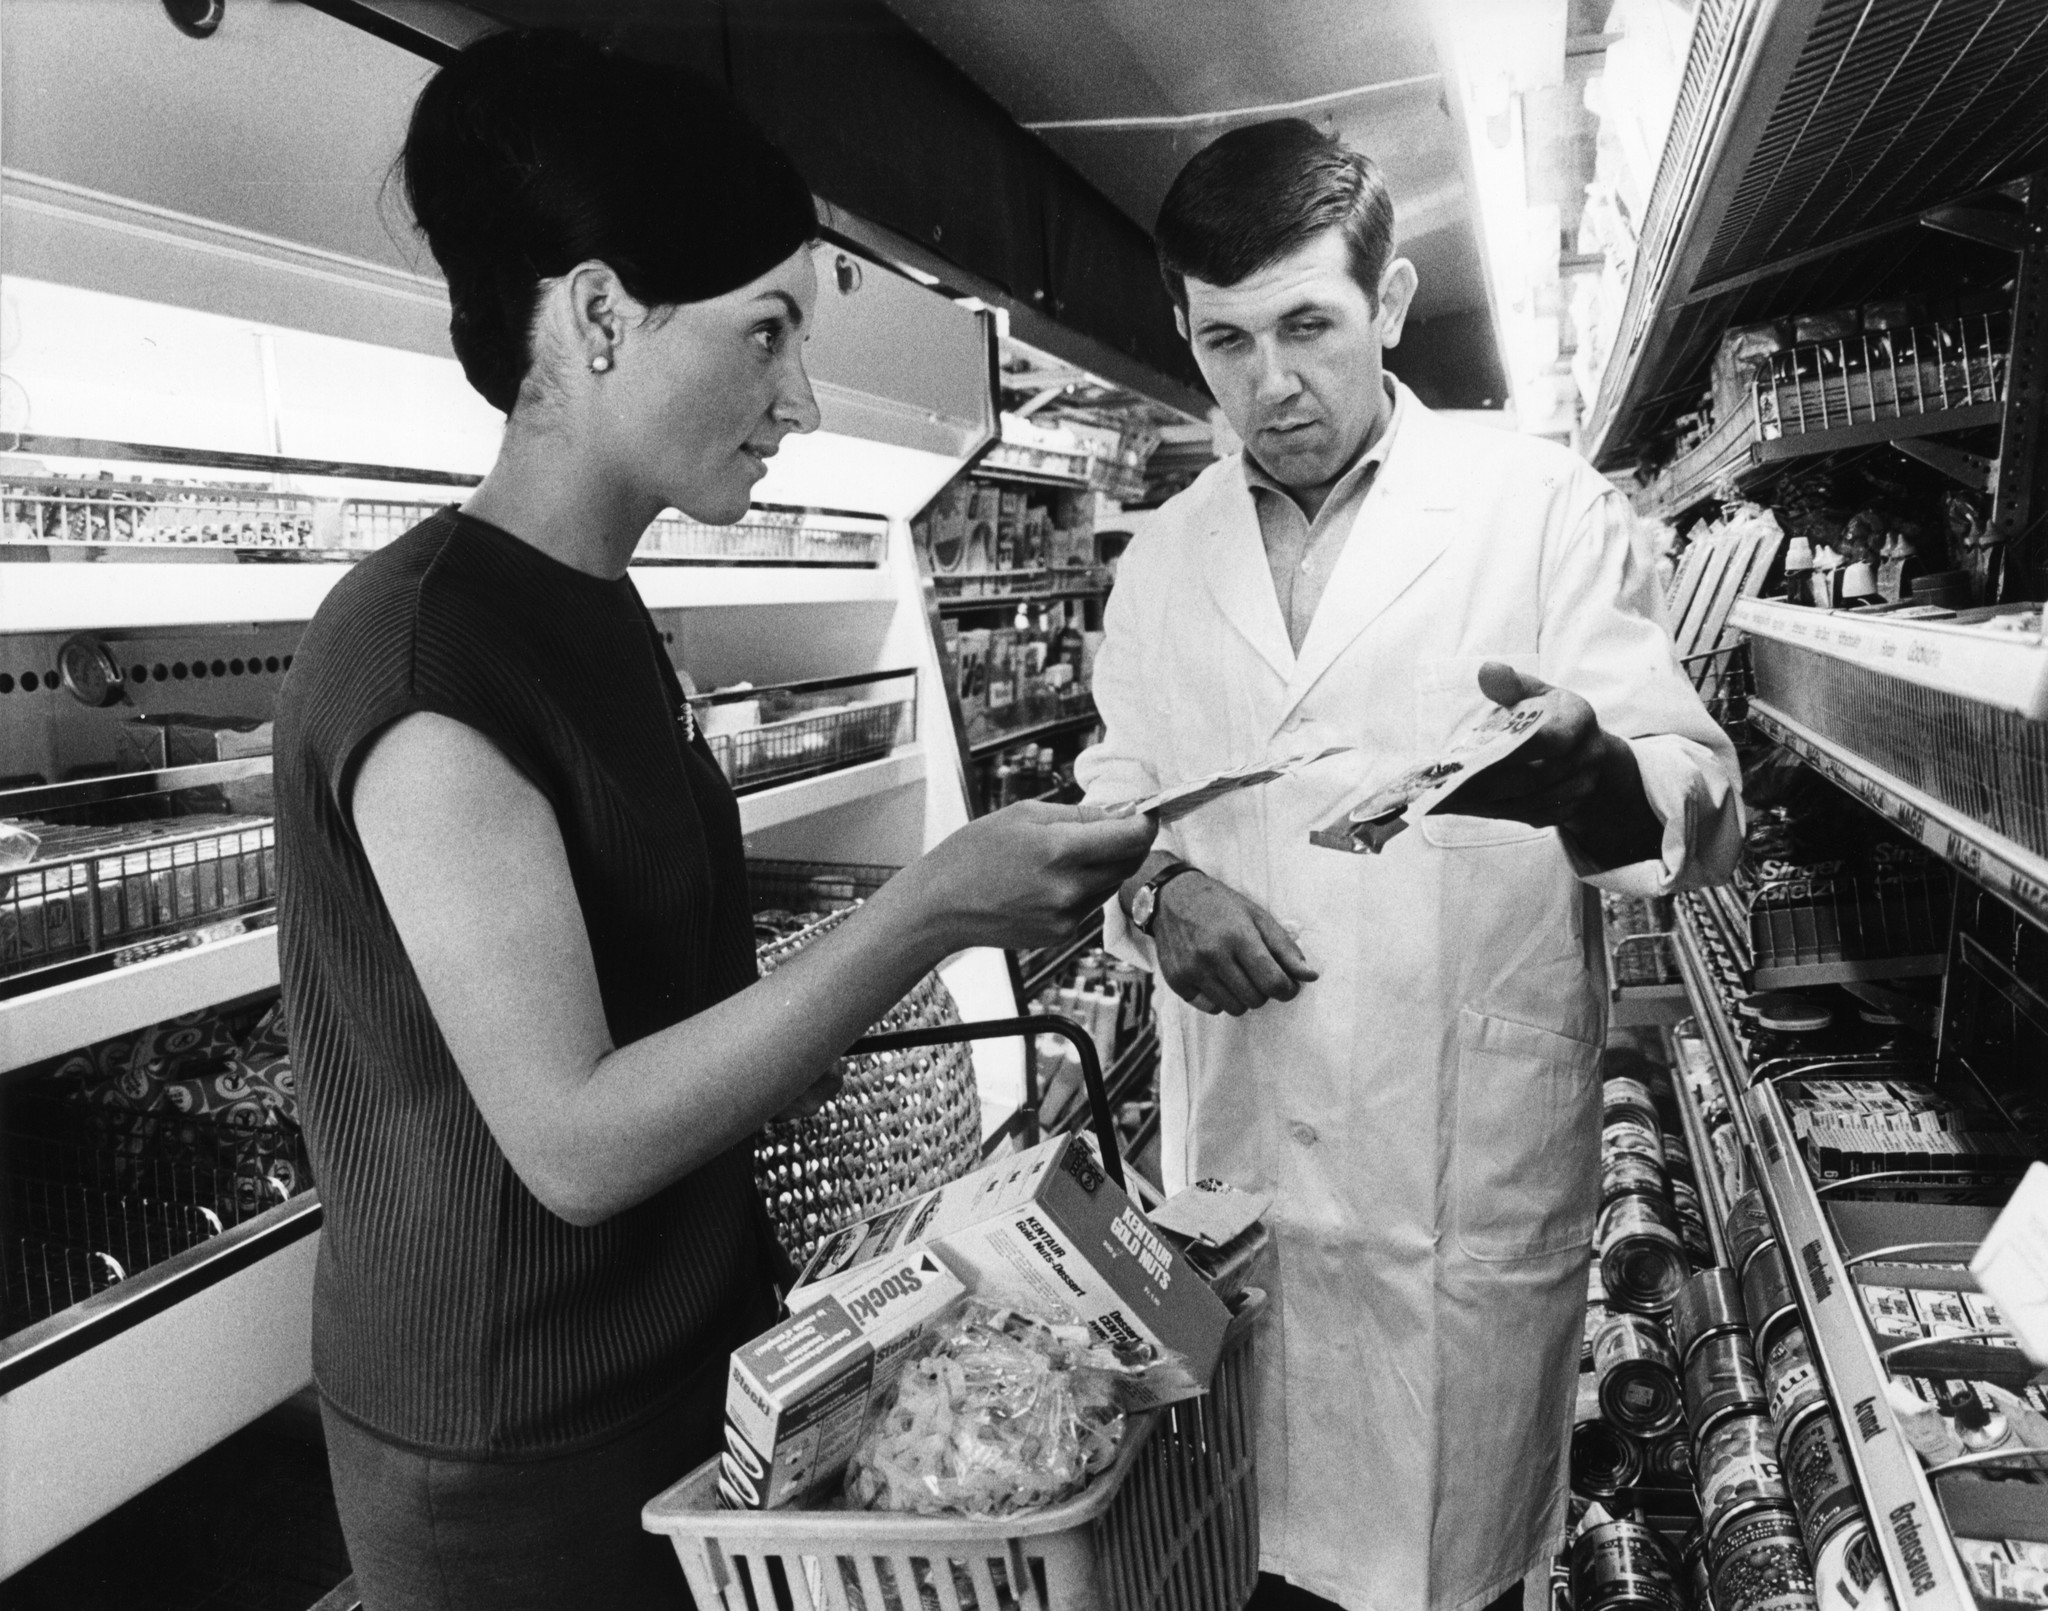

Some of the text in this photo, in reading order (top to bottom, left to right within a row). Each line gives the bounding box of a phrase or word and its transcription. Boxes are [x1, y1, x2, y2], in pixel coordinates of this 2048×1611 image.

[1898, 802, 1926, 841] MAGGI
[1759, 859, 1844, 880] Singer
[1946, 833, 1982, 882] MAGGI
[1015, 1220, 1034, 1243] Gold
[1032, 1239, 1087, 1298] Nuts-Dessert
[1025, 1216, 1066, 1258] KENTAUR
[1110, 1216, 1171, 1290] GOLD NUTS
[1122, 1205, 1173, 1270] KENTAUR
[847, 1266, 923, 1327] Stocki
[876, 1323, 923, 1365] Stocki
[1109, 1310, 1144, 1343] Dessert
[733, 1367, 771, 1417] Stocki
[1853, 1396, 1887, 1443] Aromat
[1889, 1501, 1936, 1598] Bratensauce
